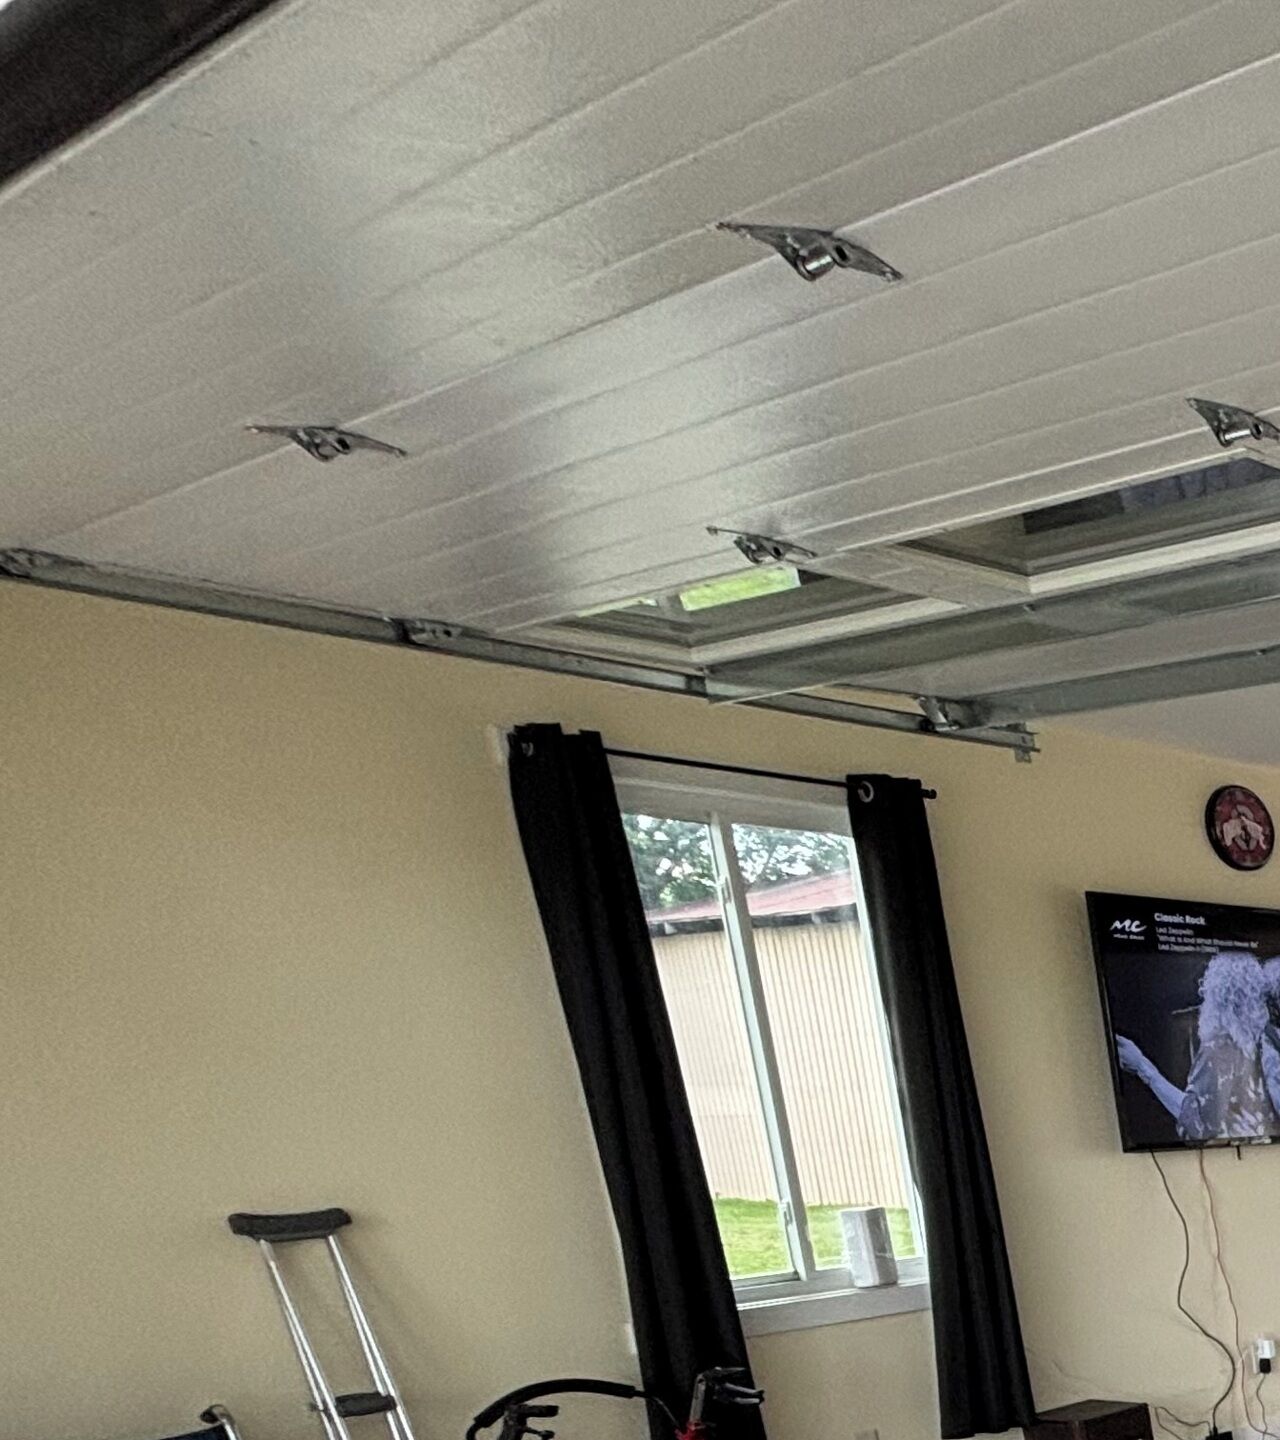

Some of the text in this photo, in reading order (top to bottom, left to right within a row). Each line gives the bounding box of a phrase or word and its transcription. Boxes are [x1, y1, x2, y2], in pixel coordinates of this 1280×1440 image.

[1110, 918, 1147, 933] MC
[1154, 912, 1207, 926] Classic Rock
